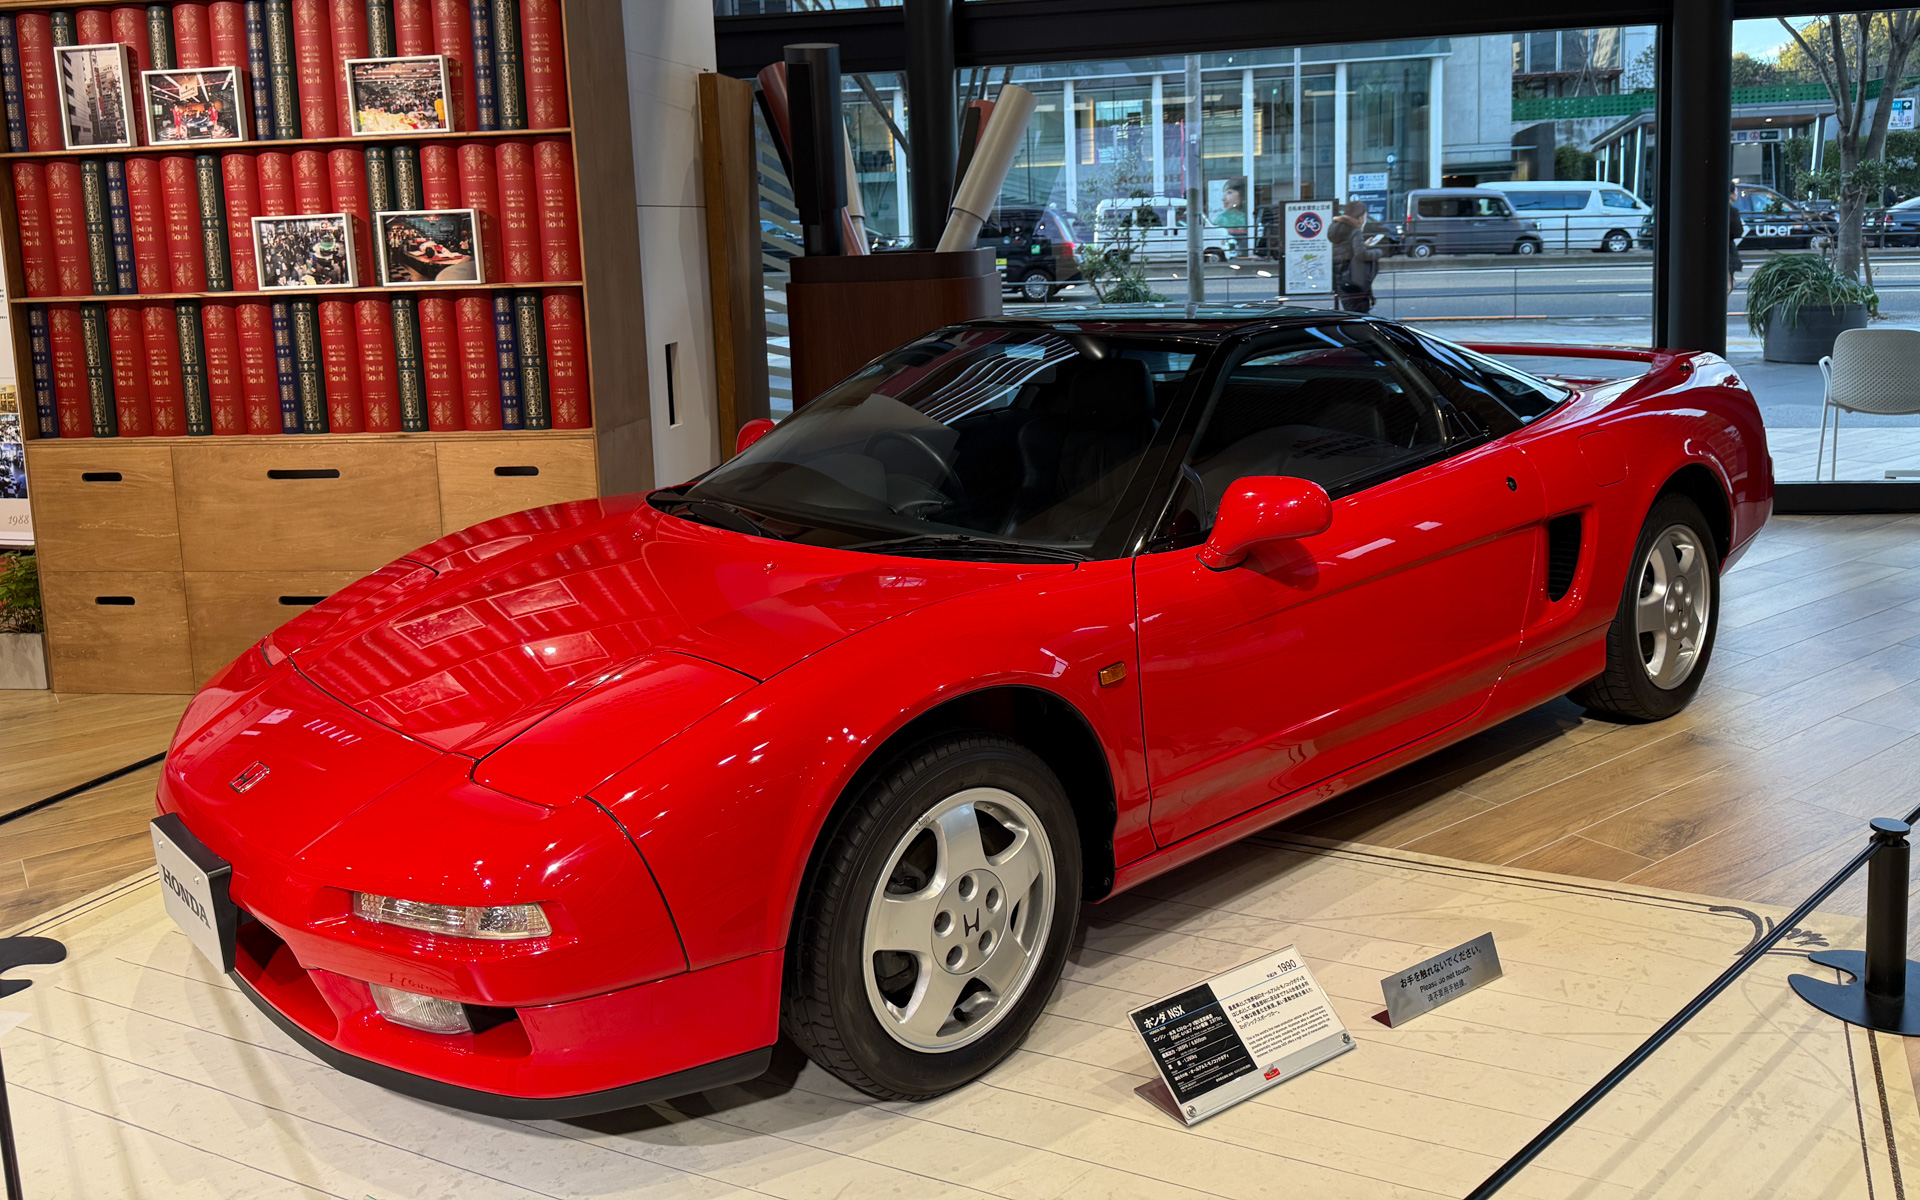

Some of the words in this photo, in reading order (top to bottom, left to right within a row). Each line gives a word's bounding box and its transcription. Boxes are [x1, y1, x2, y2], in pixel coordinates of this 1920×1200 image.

[1756, 224, 1794, 236] Uber
[8, 514, 30, 526] 1988
[160, 864, 212, 930] HONDA
[1277, 959, 1296, 972] 1990
[1400, 946, 1481, 988] お手を触れないでください。
[1420, 981, 1437, 993] Please
[1446, 972, 1455, 980] not
[1455, 965, 1472, 976] touch.
[1144, 1012, 1166, 1028] ホンダ
[1167, 1005, 1185, 1019] NSX
